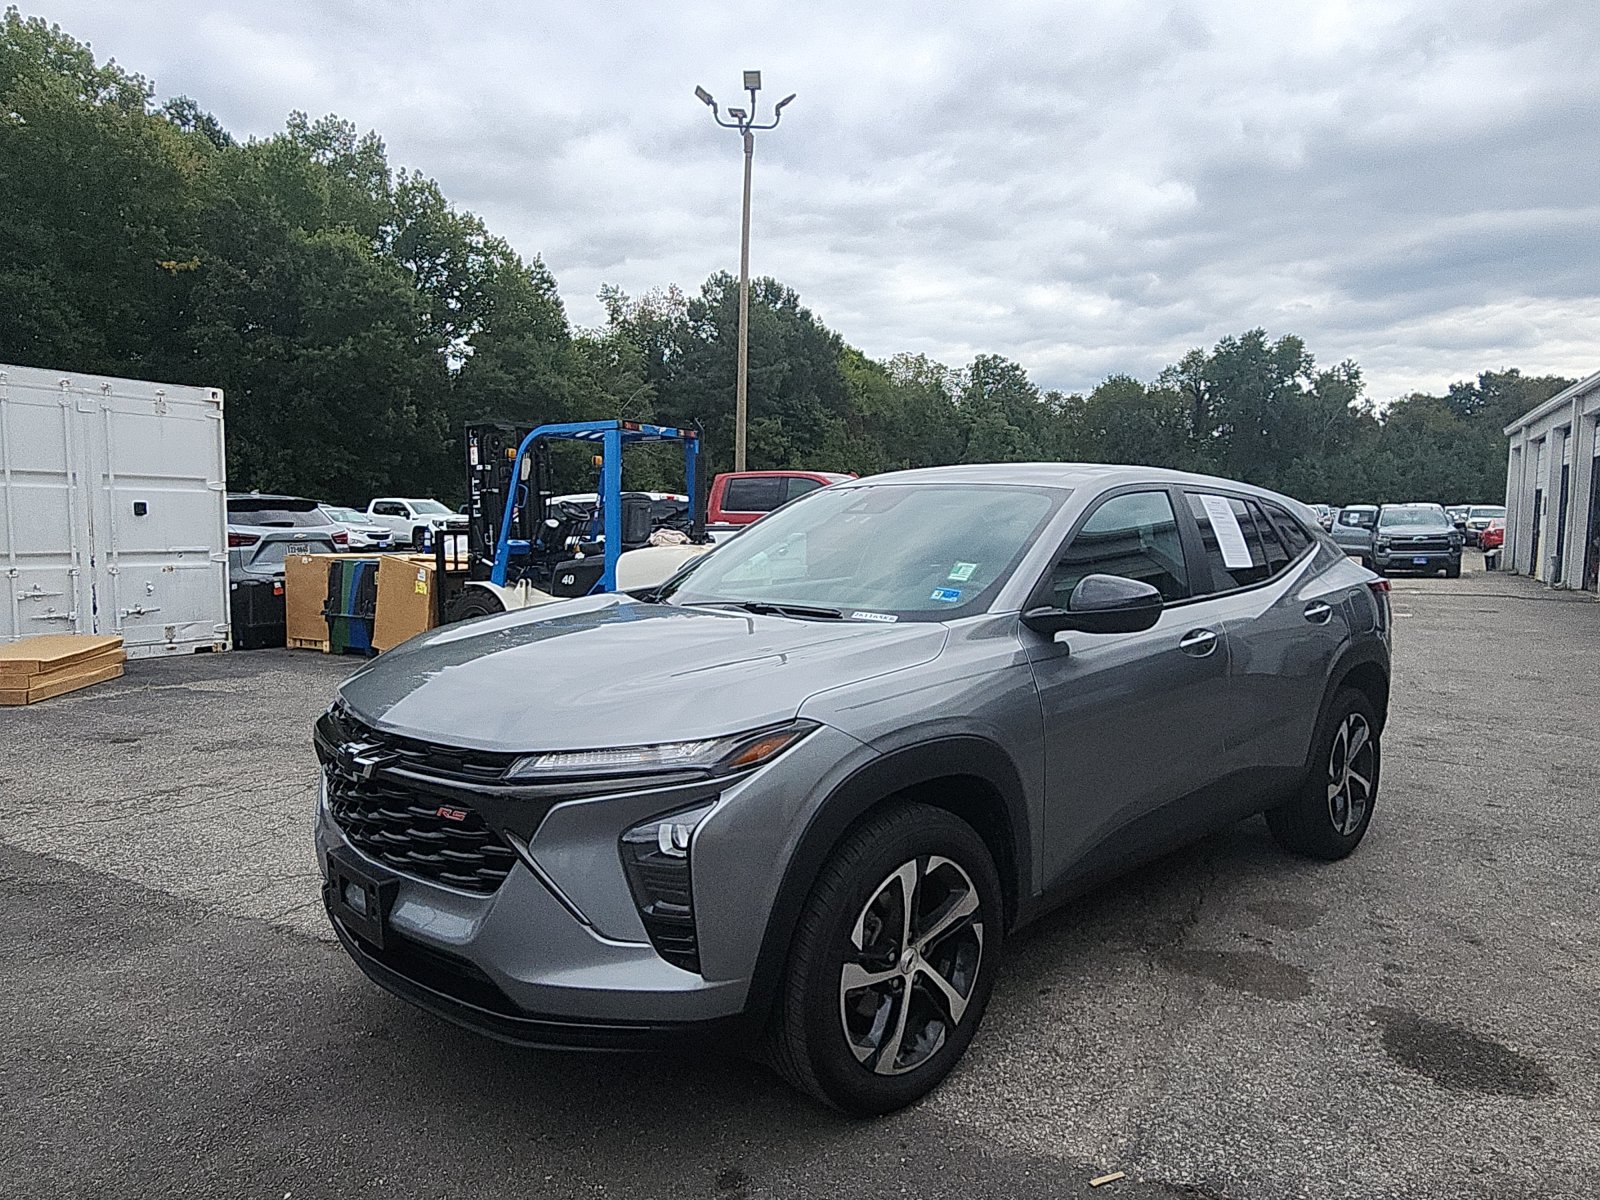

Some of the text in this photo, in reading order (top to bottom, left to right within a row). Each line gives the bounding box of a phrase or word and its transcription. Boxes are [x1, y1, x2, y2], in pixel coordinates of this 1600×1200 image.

[471, 477, 482, 518] FLIFT
[561, 574, 575, 585] 40
[436, 807, 467, 821] RS
